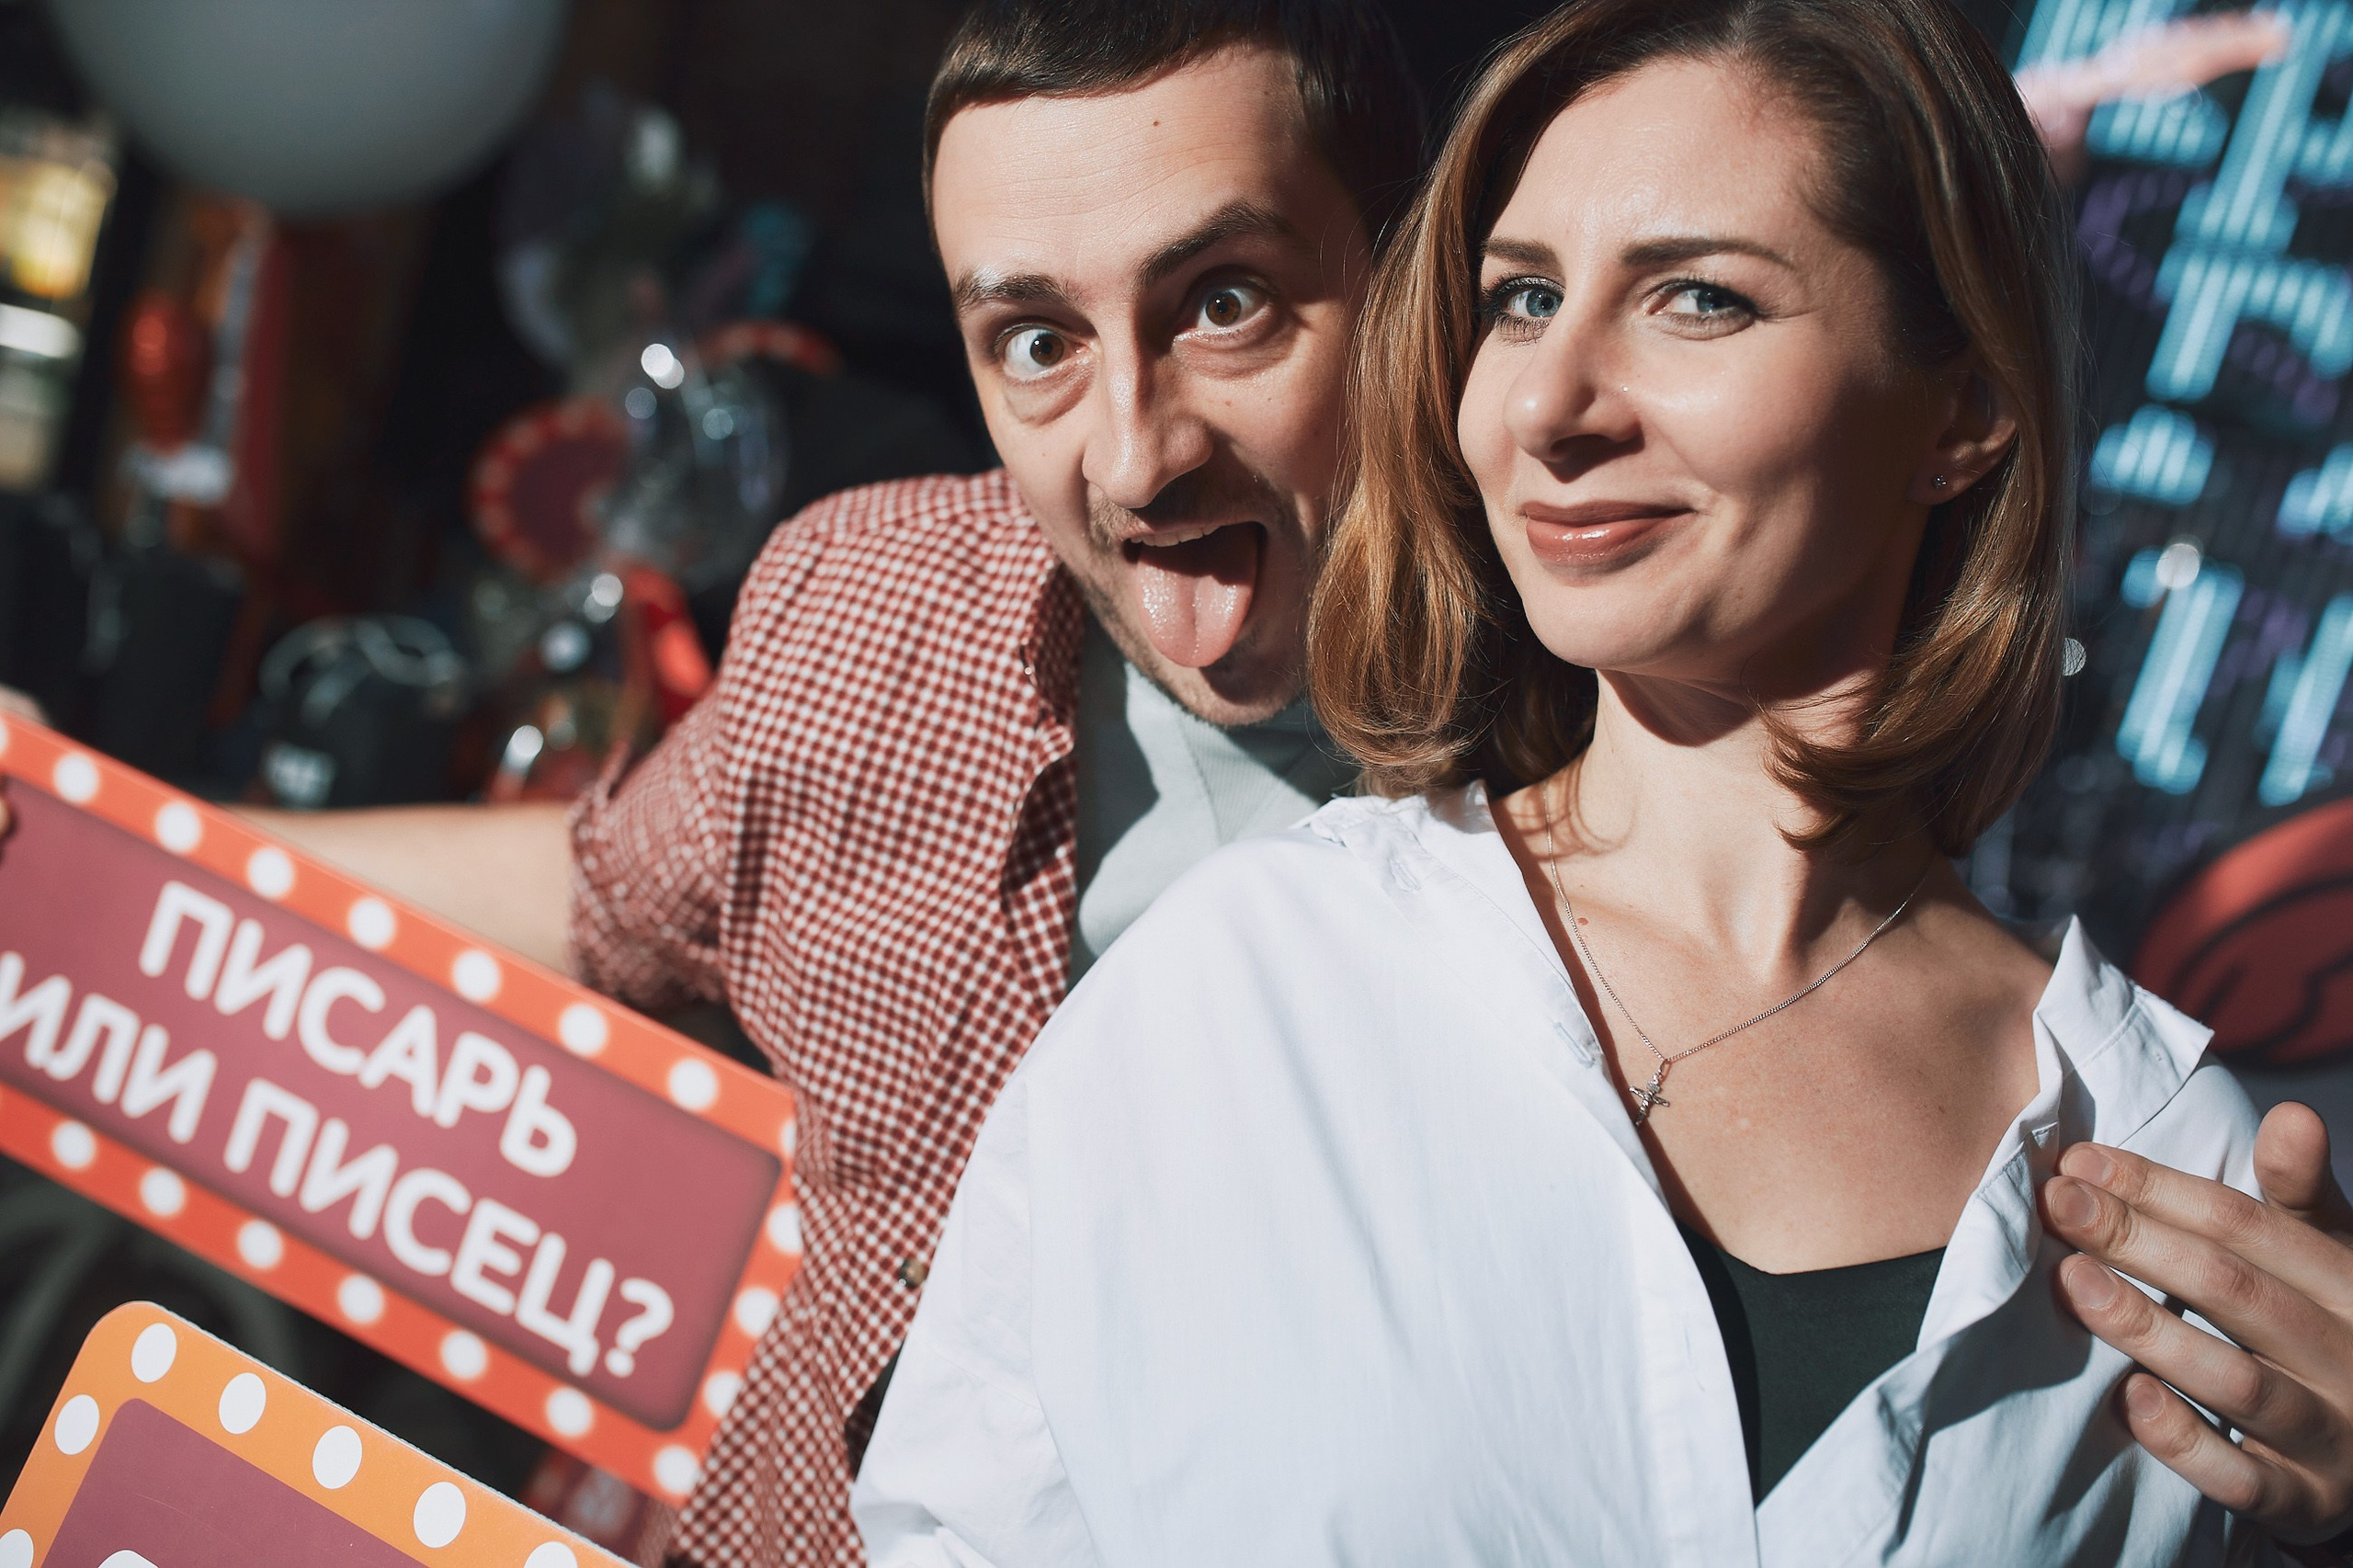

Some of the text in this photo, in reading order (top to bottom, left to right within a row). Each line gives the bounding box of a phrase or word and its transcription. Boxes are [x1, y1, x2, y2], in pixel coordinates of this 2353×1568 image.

[0, 951, 675, 1377] ИЛИ ПИСЕЦ?
[139, 881, 577, 1177] ПИСАРЬ
